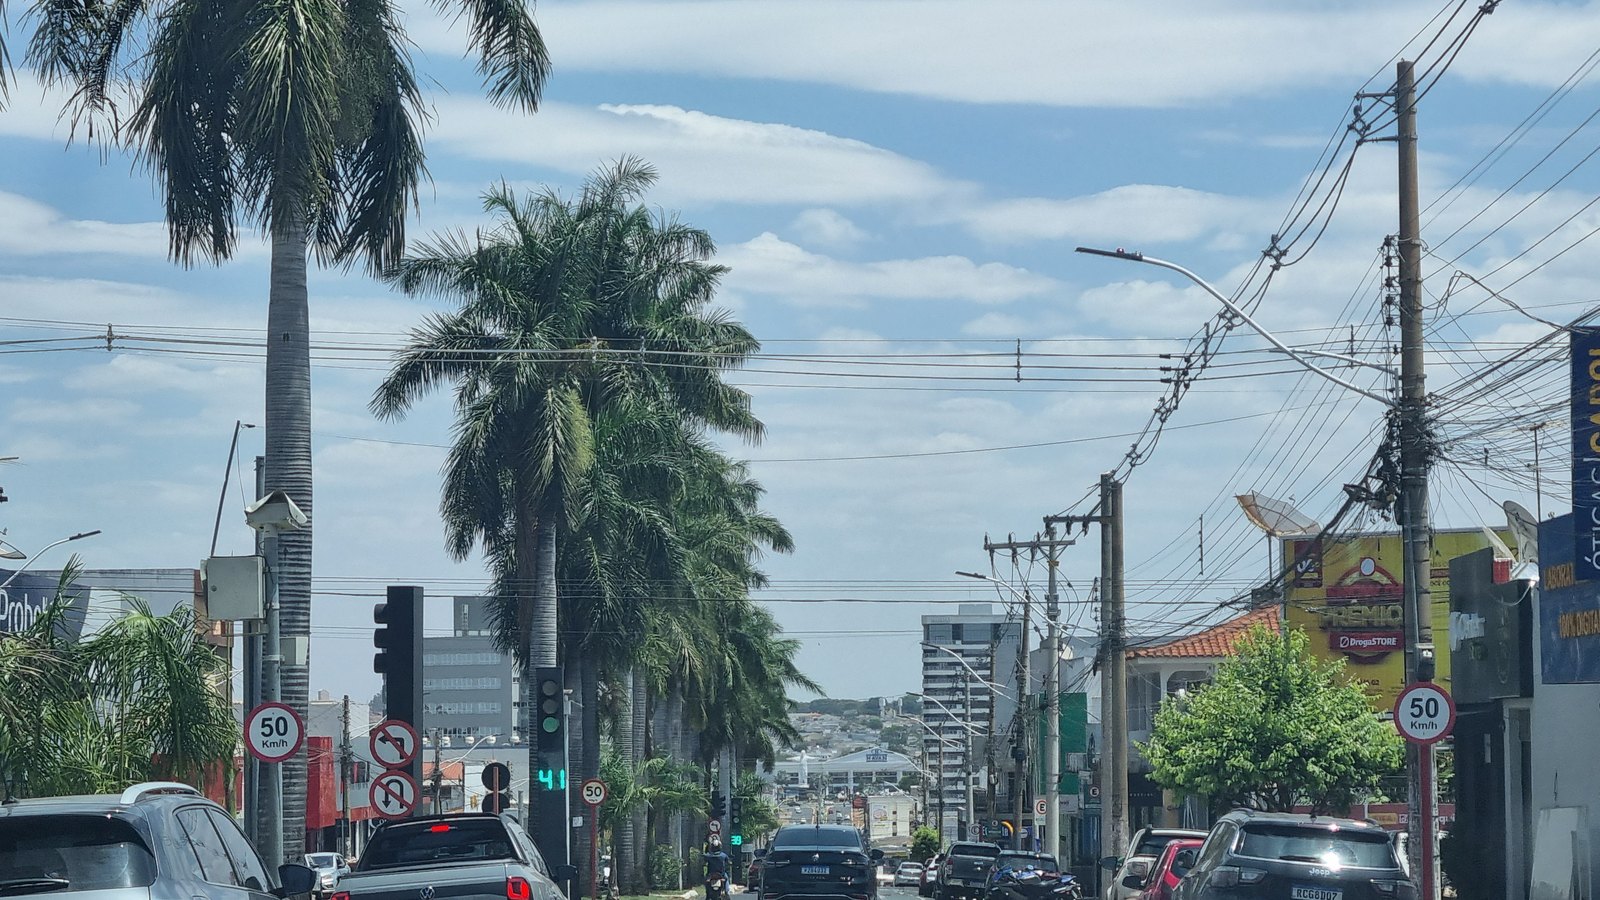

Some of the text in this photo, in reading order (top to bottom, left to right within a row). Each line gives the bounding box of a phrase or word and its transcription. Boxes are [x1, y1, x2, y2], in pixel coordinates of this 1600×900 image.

[1350, 637, 1397, 648] DrogaSTORE
[1410, 697, 1439, 718] 50
[261, 716, 288, 737] 50
[1411, 721, 1438, 730] Km/h
[262, 740, 288, 748] Km/h
[538, 769, 565, 790] 41
[586, 786, 602, 797] 50
